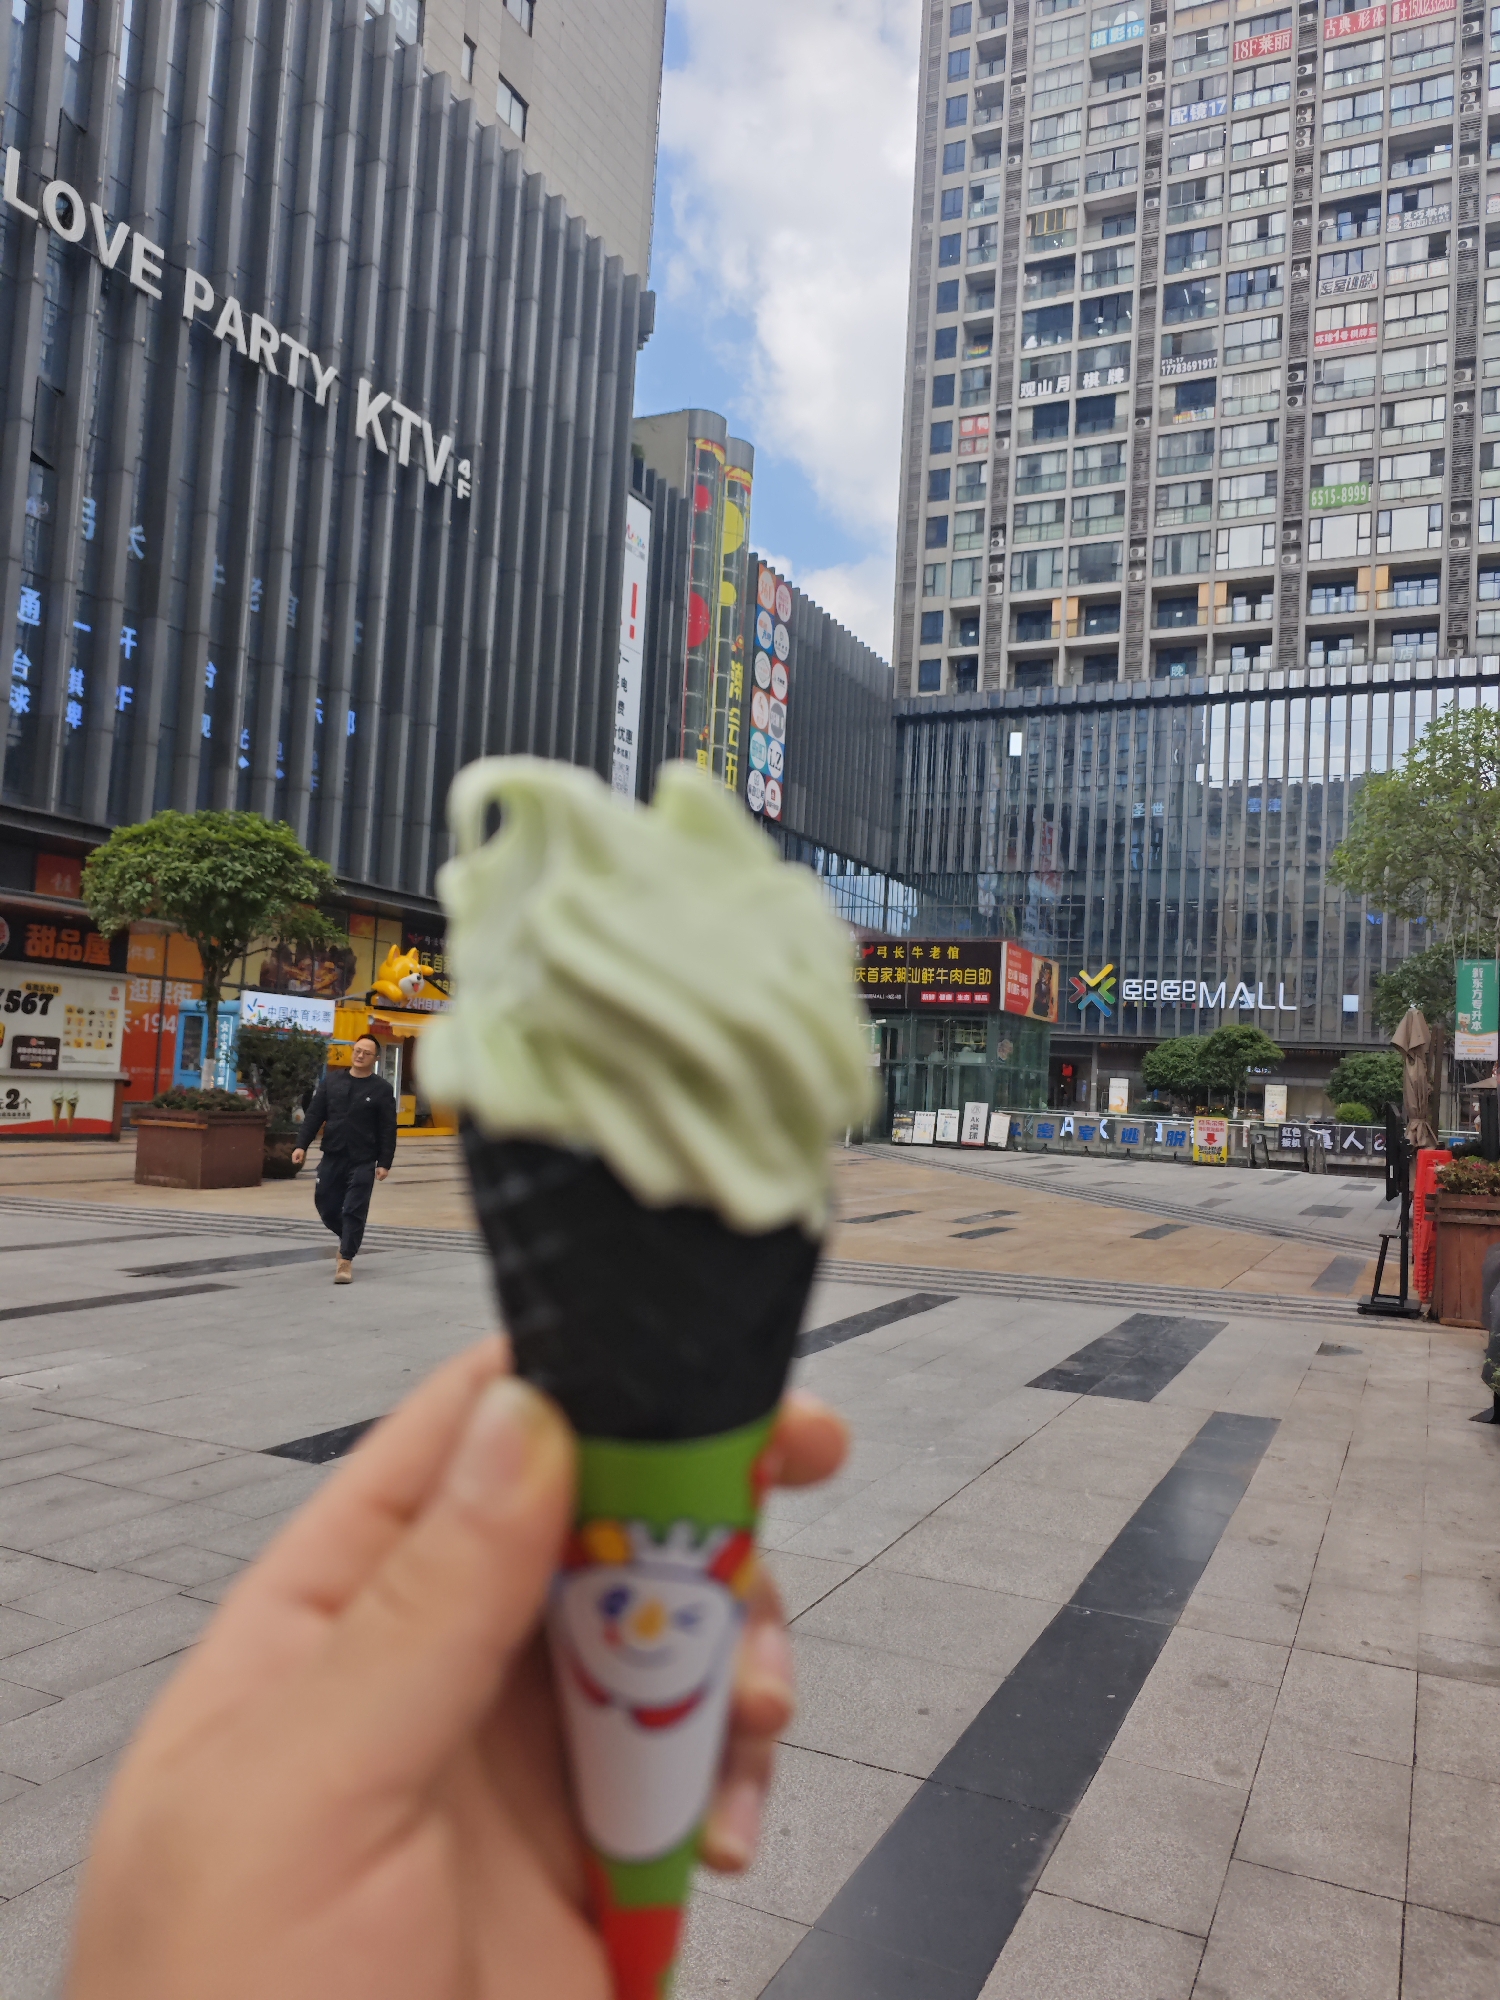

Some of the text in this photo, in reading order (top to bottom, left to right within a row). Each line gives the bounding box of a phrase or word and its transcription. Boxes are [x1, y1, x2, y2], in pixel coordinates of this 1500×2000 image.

[3, 146, 471, 500] LOVE PARTY KTV 4F
[1162, 357, 1218, 375] 17783691917
[1020, 368, 1124, 398] 观山月 棋牌
[1311, 484, 1366, 506] 6515-8999
[25, 924, 111, 966] 甜品屋
[847, 966, 992, 985] 庆首家潮汕鲜牛肉自助
[0, 989, 54, 1016] 567
[1471, 967, 1484, 1031] 新东方专升本
[268, 1005, 332, 1023] 中国体育彩票
